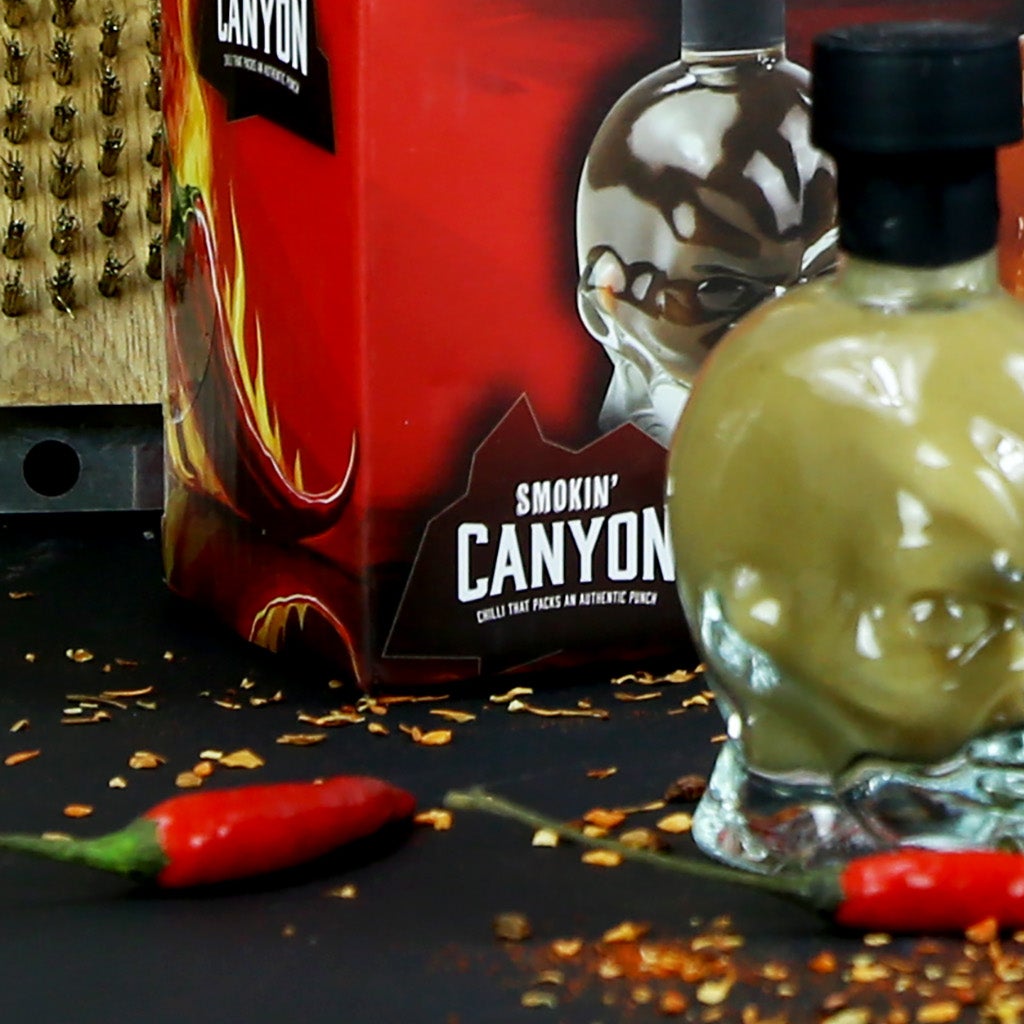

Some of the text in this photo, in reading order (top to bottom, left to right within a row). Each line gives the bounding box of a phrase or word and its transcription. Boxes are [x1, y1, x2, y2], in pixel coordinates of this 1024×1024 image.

[515, 474, 619, 516] SMOKIN'
[457, 506, 676, 603] CANYON
[476, 590, 658, 624] CHILLI THAT PACKS AN AUTHENTIC PUNCH
